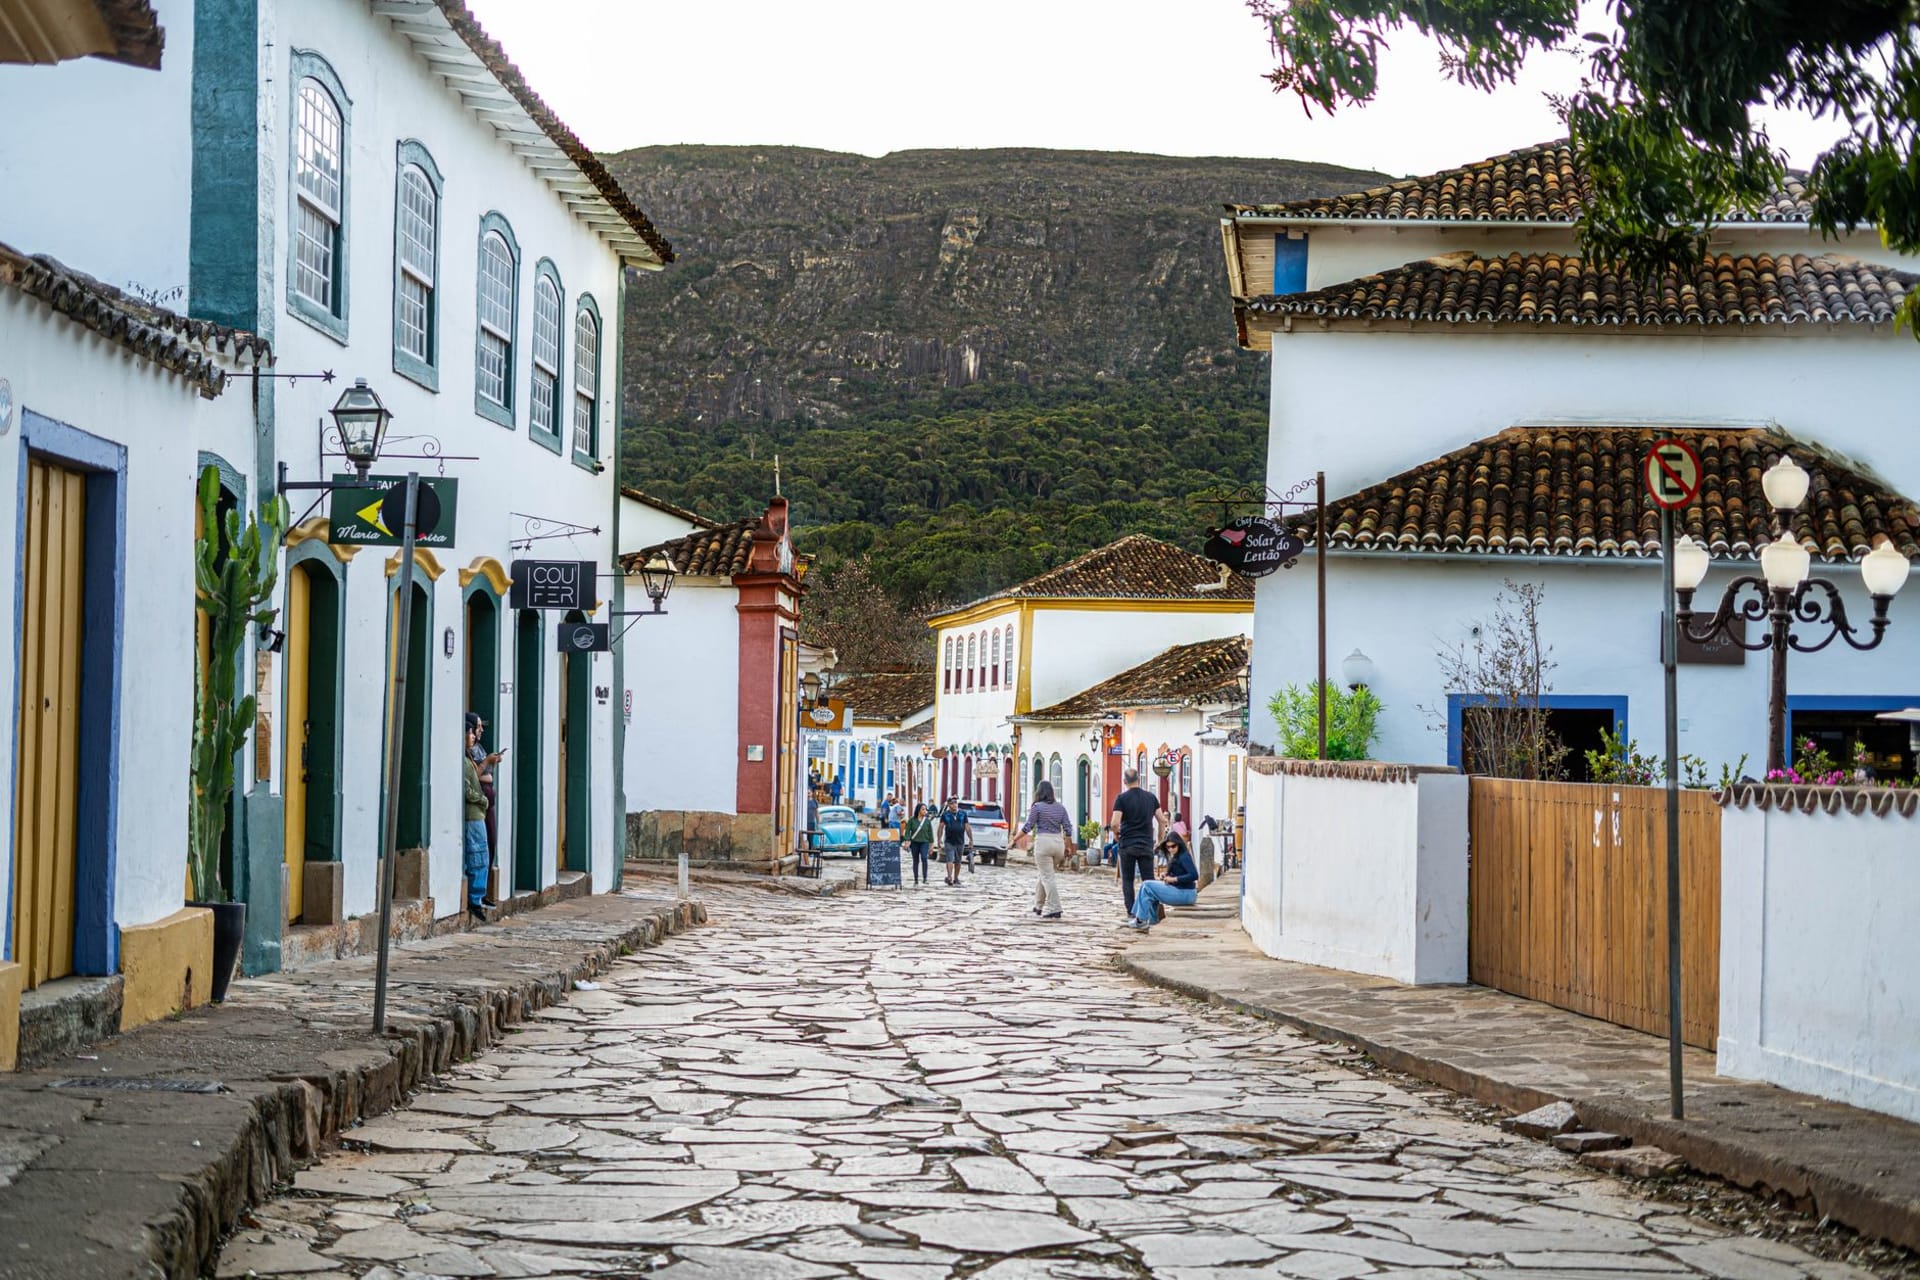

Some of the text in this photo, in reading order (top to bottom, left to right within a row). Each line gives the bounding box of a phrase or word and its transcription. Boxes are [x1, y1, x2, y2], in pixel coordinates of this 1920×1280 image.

[1659, 453, 1683, 495] E
[337, 525, 380, 540] Maria
[1246, 534, 1290, 551] Solar do
[1243, 549, 1280, 562] Leitão
[534, 585, 573, 604] FER
